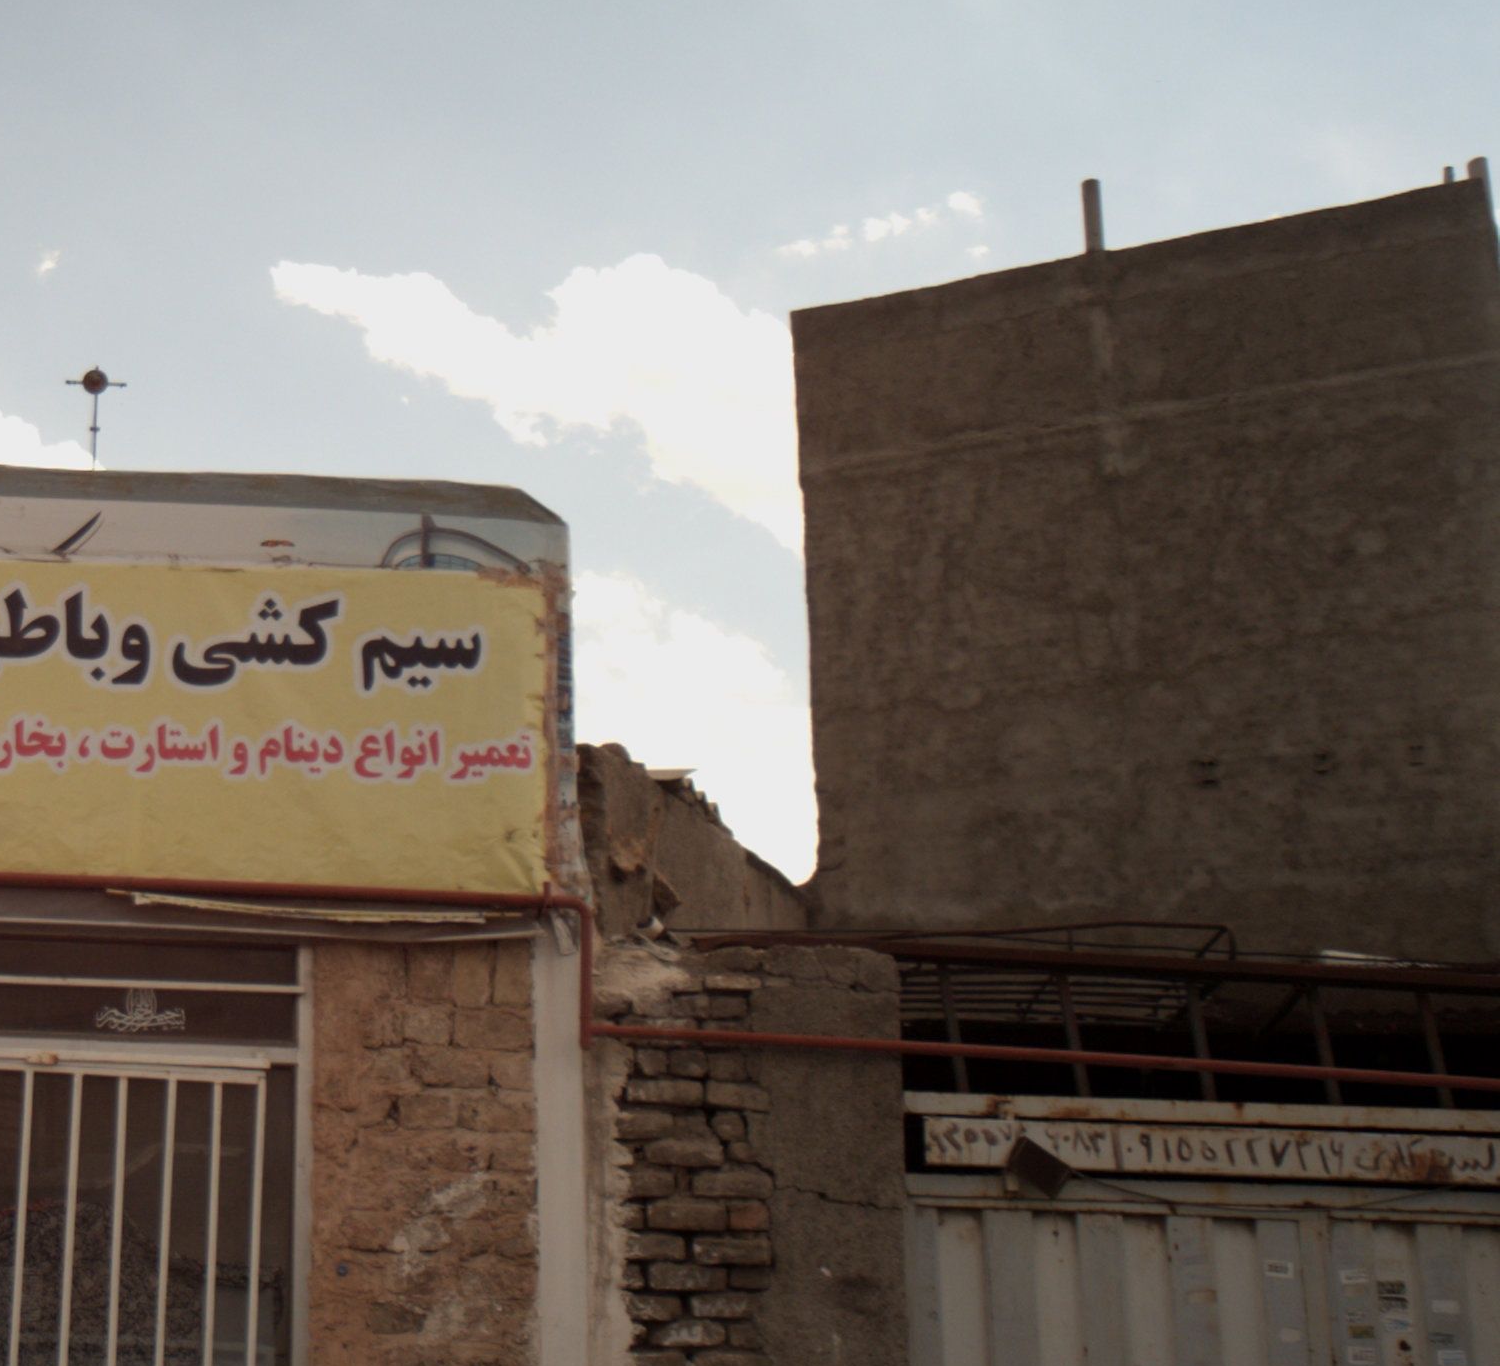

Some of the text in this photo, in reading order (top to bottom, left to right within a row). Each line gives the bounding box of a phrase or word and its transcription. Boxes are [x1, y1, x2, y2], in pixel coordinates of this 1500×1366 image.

[172, 598, 340, 687] کشی
[361, 632, 482, 691] سیم
[229, 742, 249, 775] و
[260, 726, 343, 775] دینام
[355, 729, 440, 778] انواع
[451, 734, 532, 779] تعمیر
